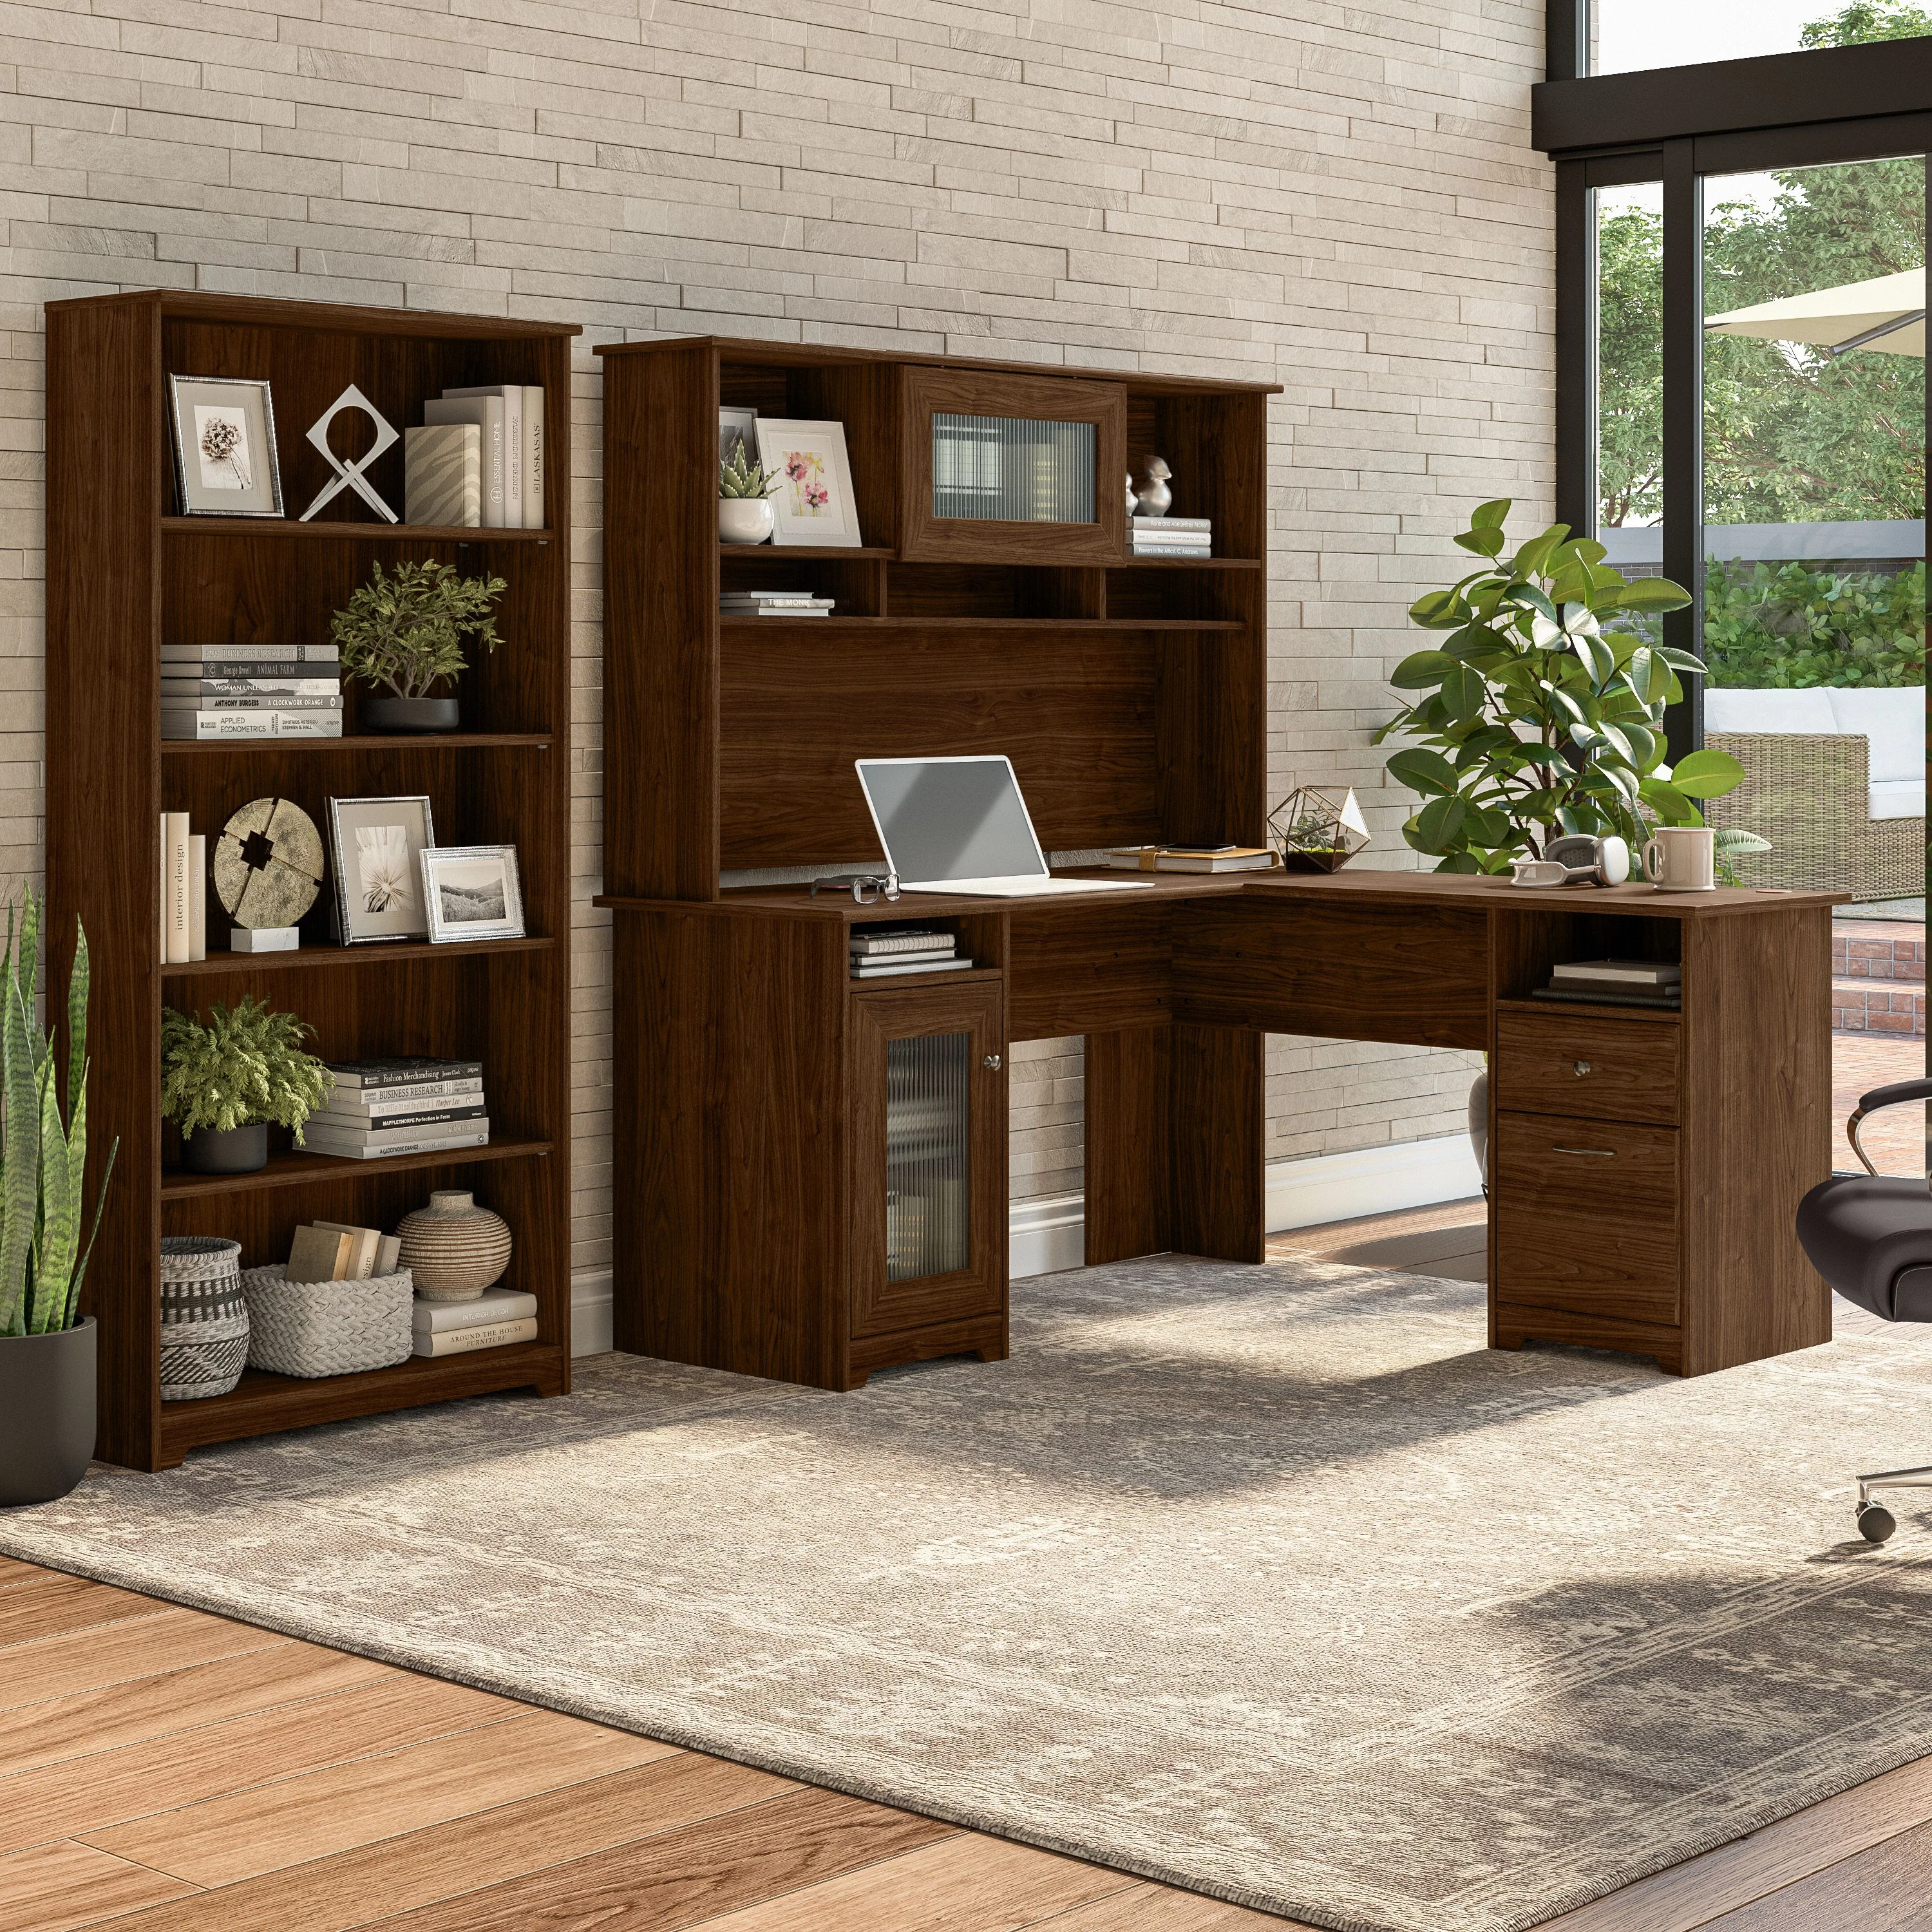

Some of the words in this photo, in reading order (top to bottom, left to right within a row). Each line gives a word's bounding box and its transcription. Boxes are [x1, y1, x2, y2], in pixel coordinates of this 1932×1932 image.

[222, 648, 256, 659] BUSINESS
[257, 648, 295, 659] RESEARCH
[223, 665, 238, 676] George
[238, 666, 251, 674] Orwell
[280, 665, 295, 674] FARM
[175, 844, 184, 882] design
[175, 886, 184, 931] interior
[383, 1073, 402, 1083] Fashion
[403, 1071, 439, 1081] Merchandising
[379, 1086, 409, 1100] BUSINESS
[410, 1084, 443, 1097] RESEARCH
[435, 1099, 451, 1108] Harper
[383, 1118, 415, 1126] MAPPLETHORPE
[462, 1311, 489, 1321] INTERIOR
[450, 1332, 480, 1343] AROUND
[499, 1325, 523, 1334] HOUSE
[466, 1335, 506, 1347] FURNITURE
